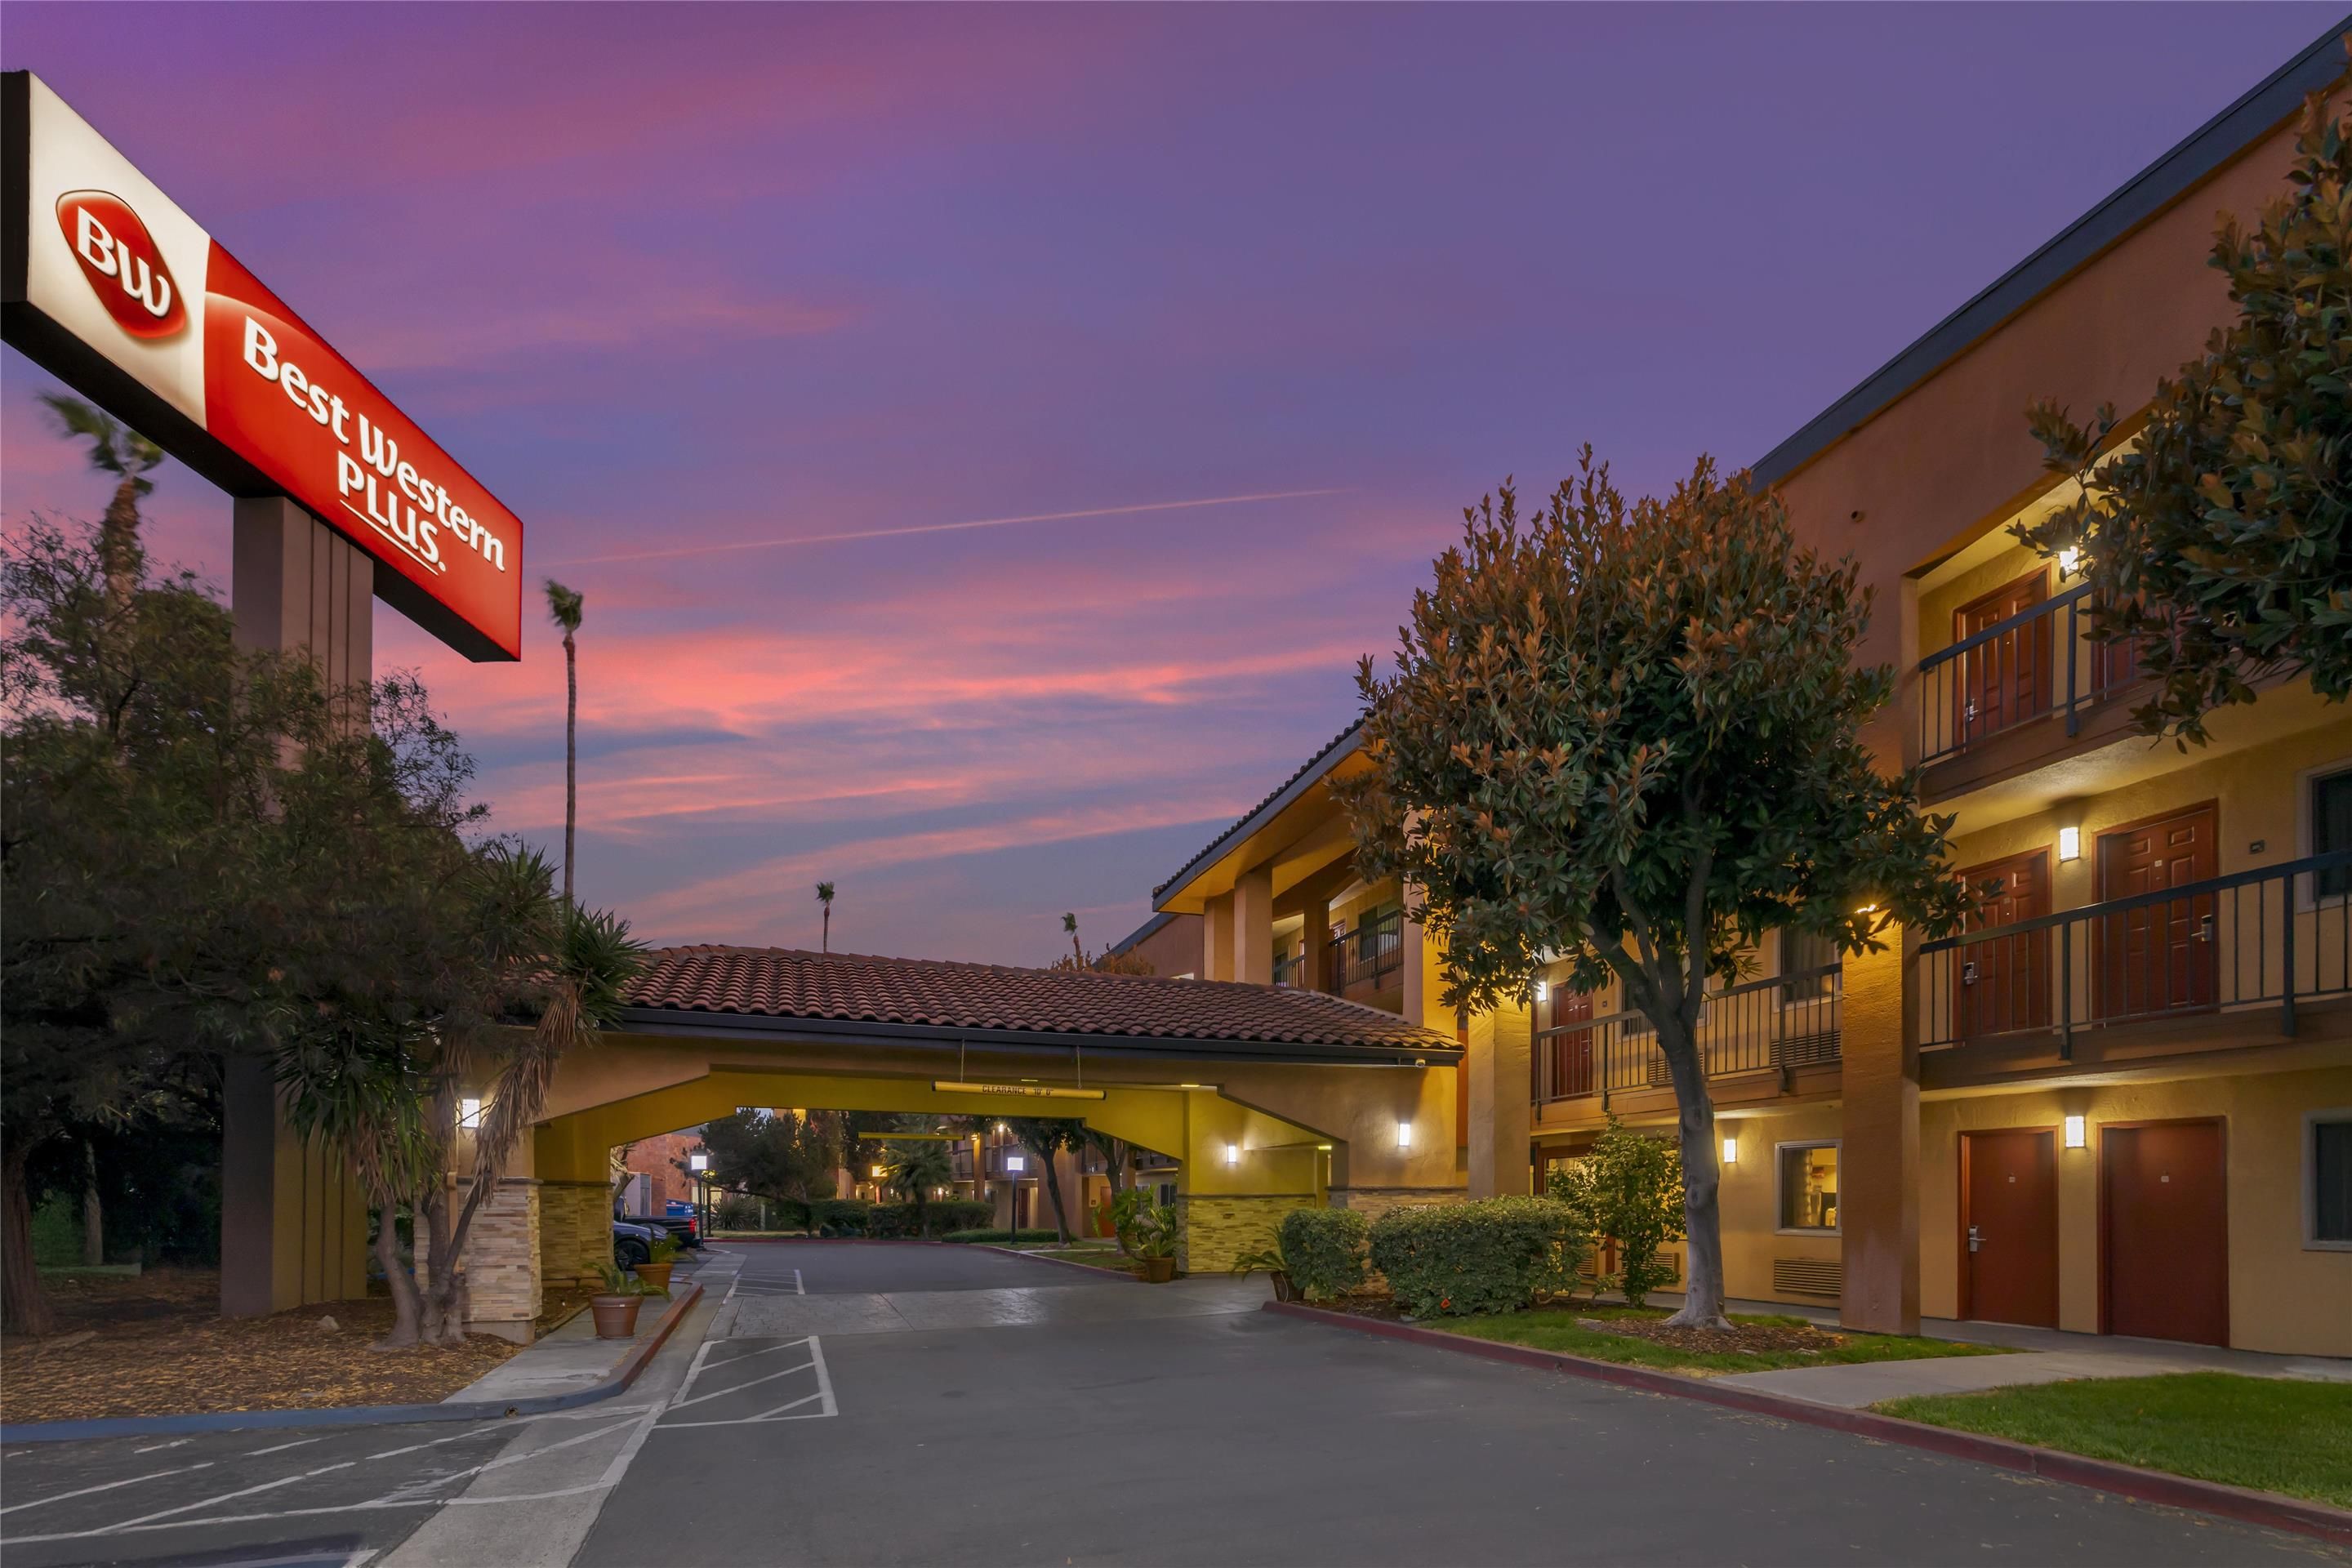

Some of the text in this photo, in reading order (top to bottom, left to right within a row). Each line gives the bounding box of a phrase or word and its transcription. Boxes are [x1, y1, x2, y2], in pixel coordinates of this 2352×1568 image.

[78, 206, 171, 317] BW
[244, 315, 506, 571] Best Western
[982, 1085, 1027, 1095] CLEARANCE
